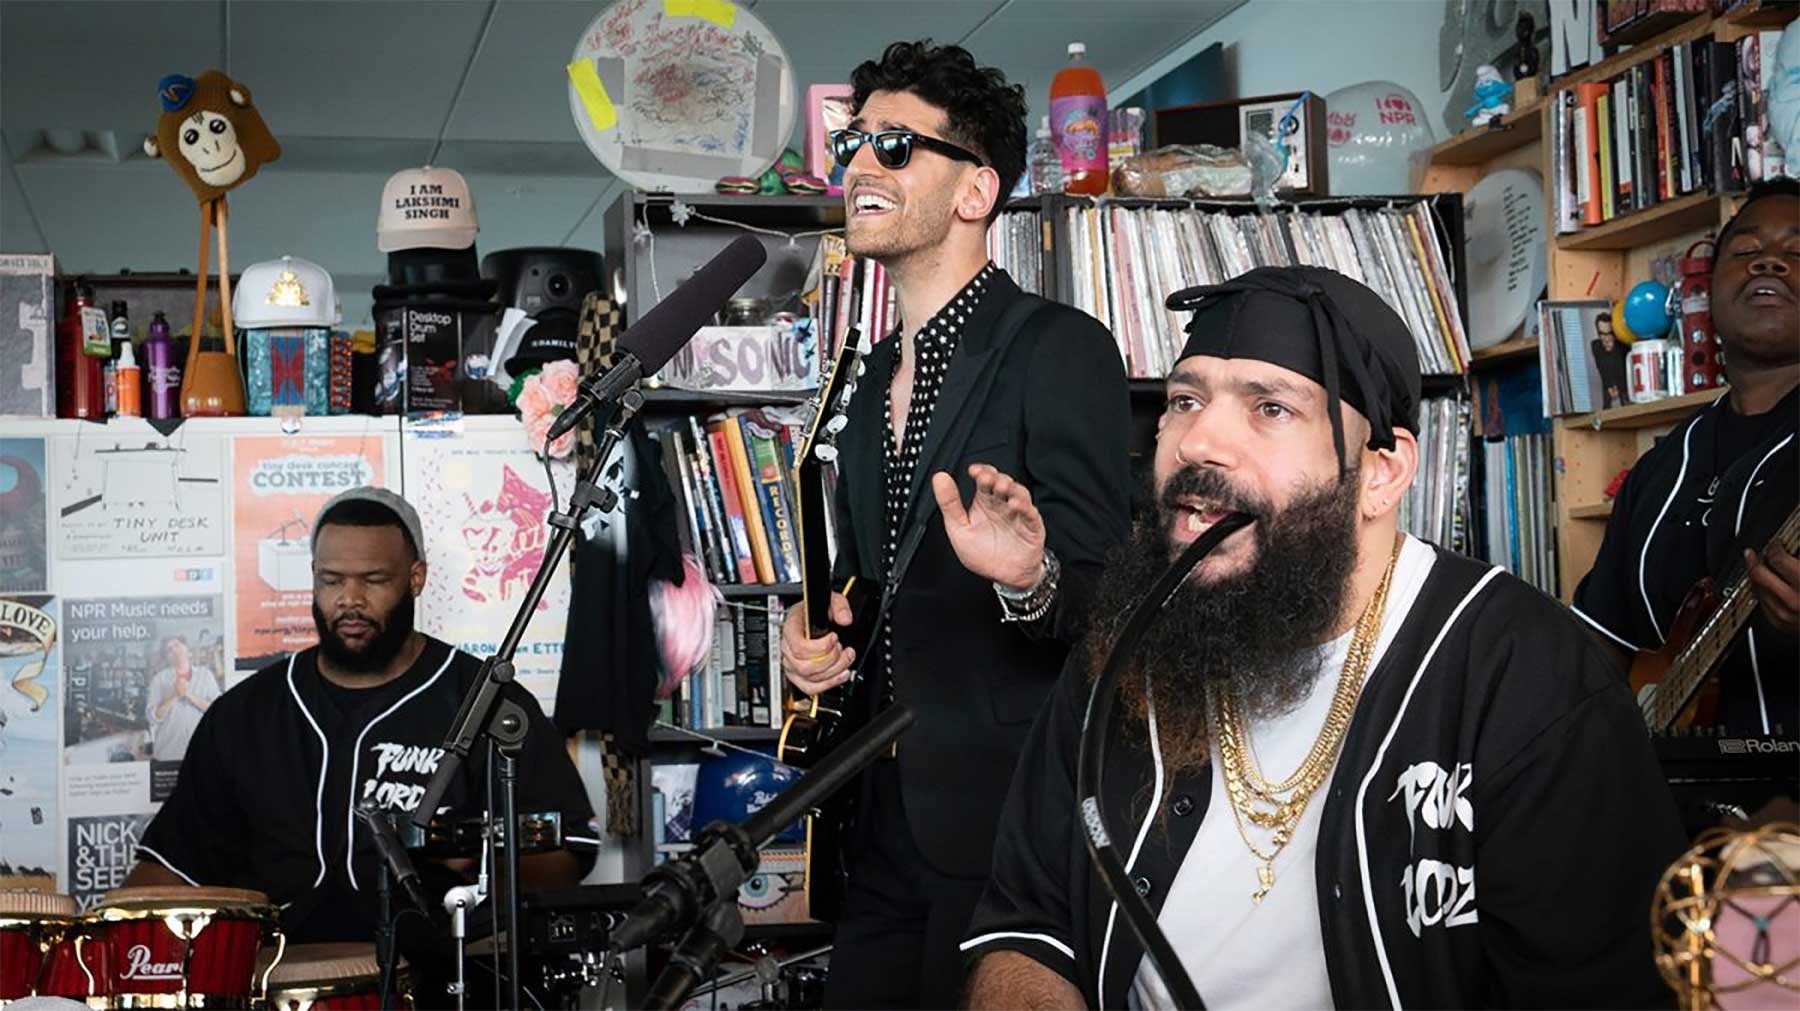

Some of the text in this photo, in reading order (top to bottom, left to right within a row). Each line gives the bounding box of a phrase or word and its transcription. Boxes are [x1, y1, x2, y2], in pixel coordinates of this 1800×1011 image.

[1380, 111, 1416, 126] NPR
[411, 184, 442, 195] I AM
[396, 197, 459, 209] LAKSHMI
[405, 208, 449, 220] SINGH
[409, 310, 452, 326] Desktop
[410, 322, 437, 336] Drum
[253, 470, 367, 489] CONTEST
[114, 517, 158, 529] TINY
[168, 516, 210, 529] DESK
[769, 486, 799, 569] RECORDS
[139, 531, 179, 543] UNIT
[71, 600, 209, 619] NPR Music needs
[1, 604, 51, 637] LOVE
[71, 622, 151, 643] your help.
[370, 742, 446, 779] FUNK
[77, 821, 137, 846] NICK
